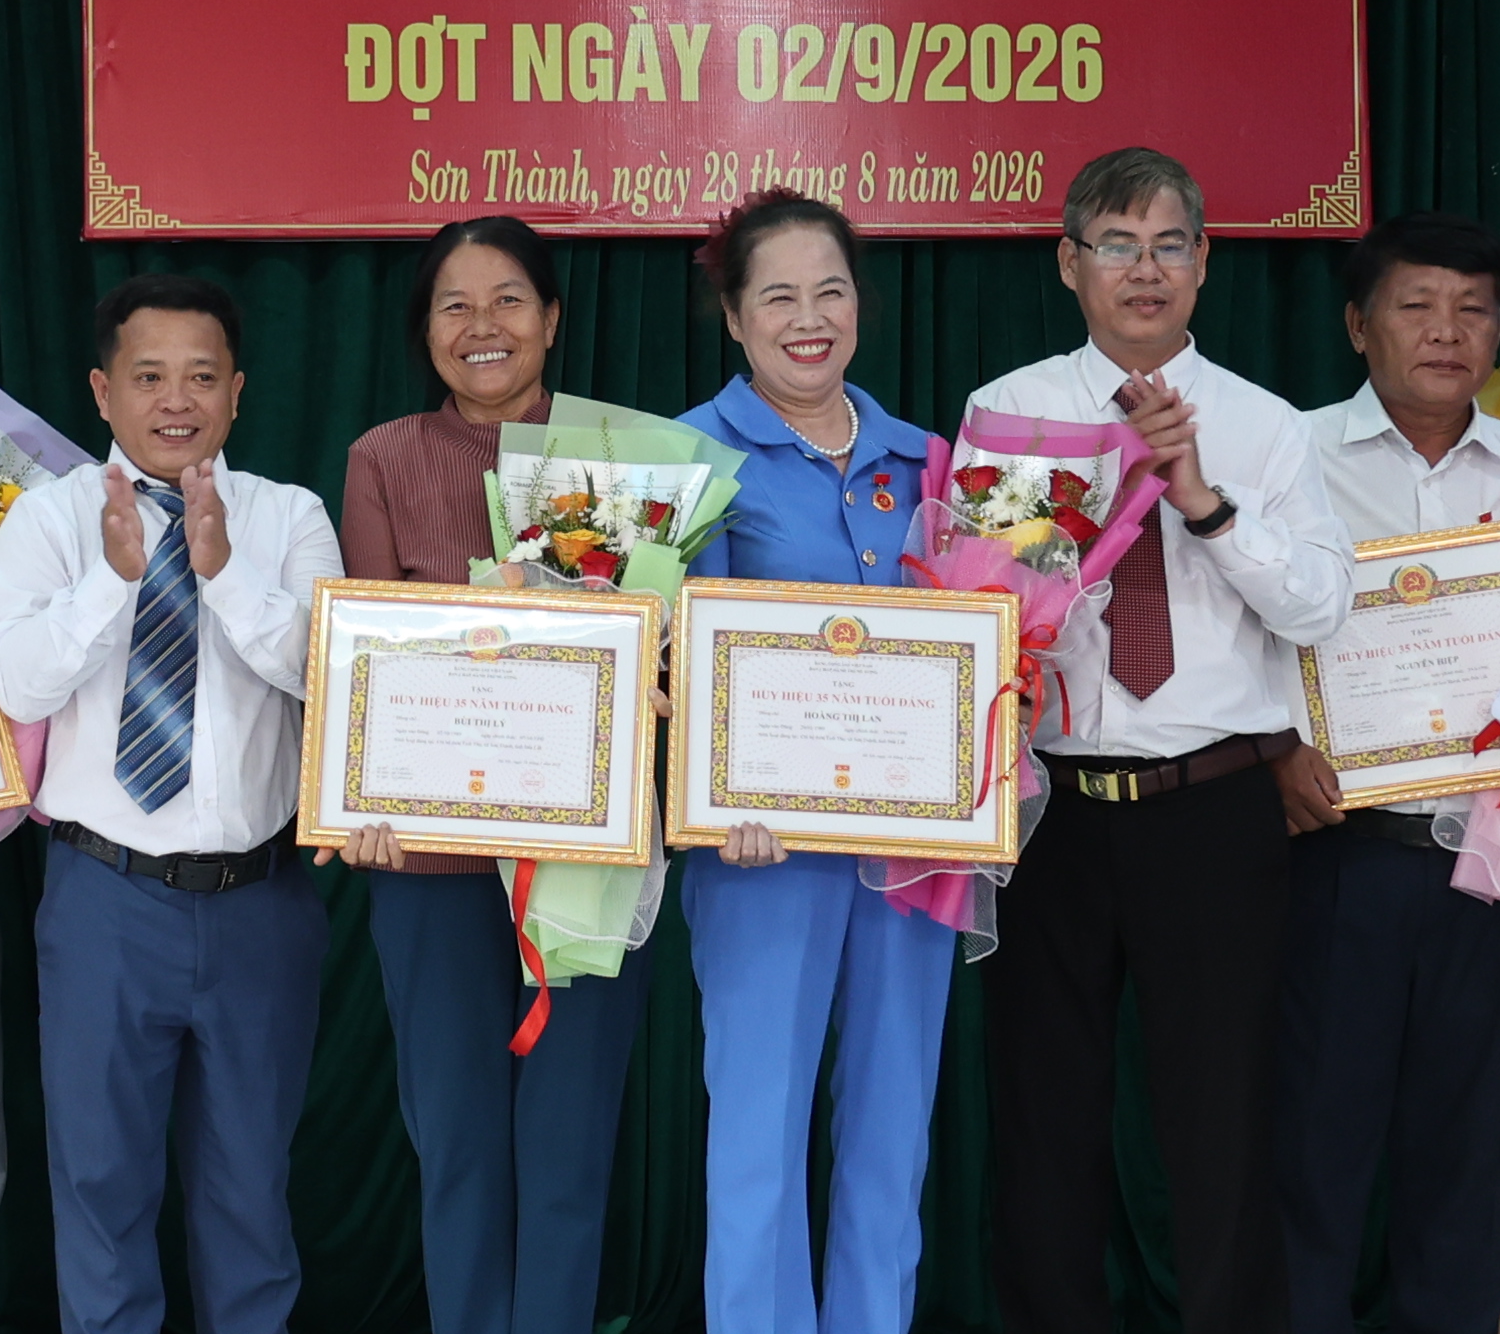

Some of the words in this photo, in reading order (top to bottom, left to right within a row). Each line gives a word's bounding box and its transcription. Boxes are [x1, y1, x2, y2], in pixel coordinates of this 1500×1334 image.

[343, 14, 488, 122] ĐỢT
[512, 6, 712, 104] NGÀY
[738, 22, 1104, 104] 02/9/2026
[408, 149, 470, 204] Sơn
[483, 149, 599, 214] Thành,
[612, 152, 692, 216] ngày
[702, 150, 739, 203] 28
[749, 151, 848, 211] tháng
[857, 150, 878, 204] 8
[886, 156, 960, 204] năm
[970, 150, 1047, 204] 2026
